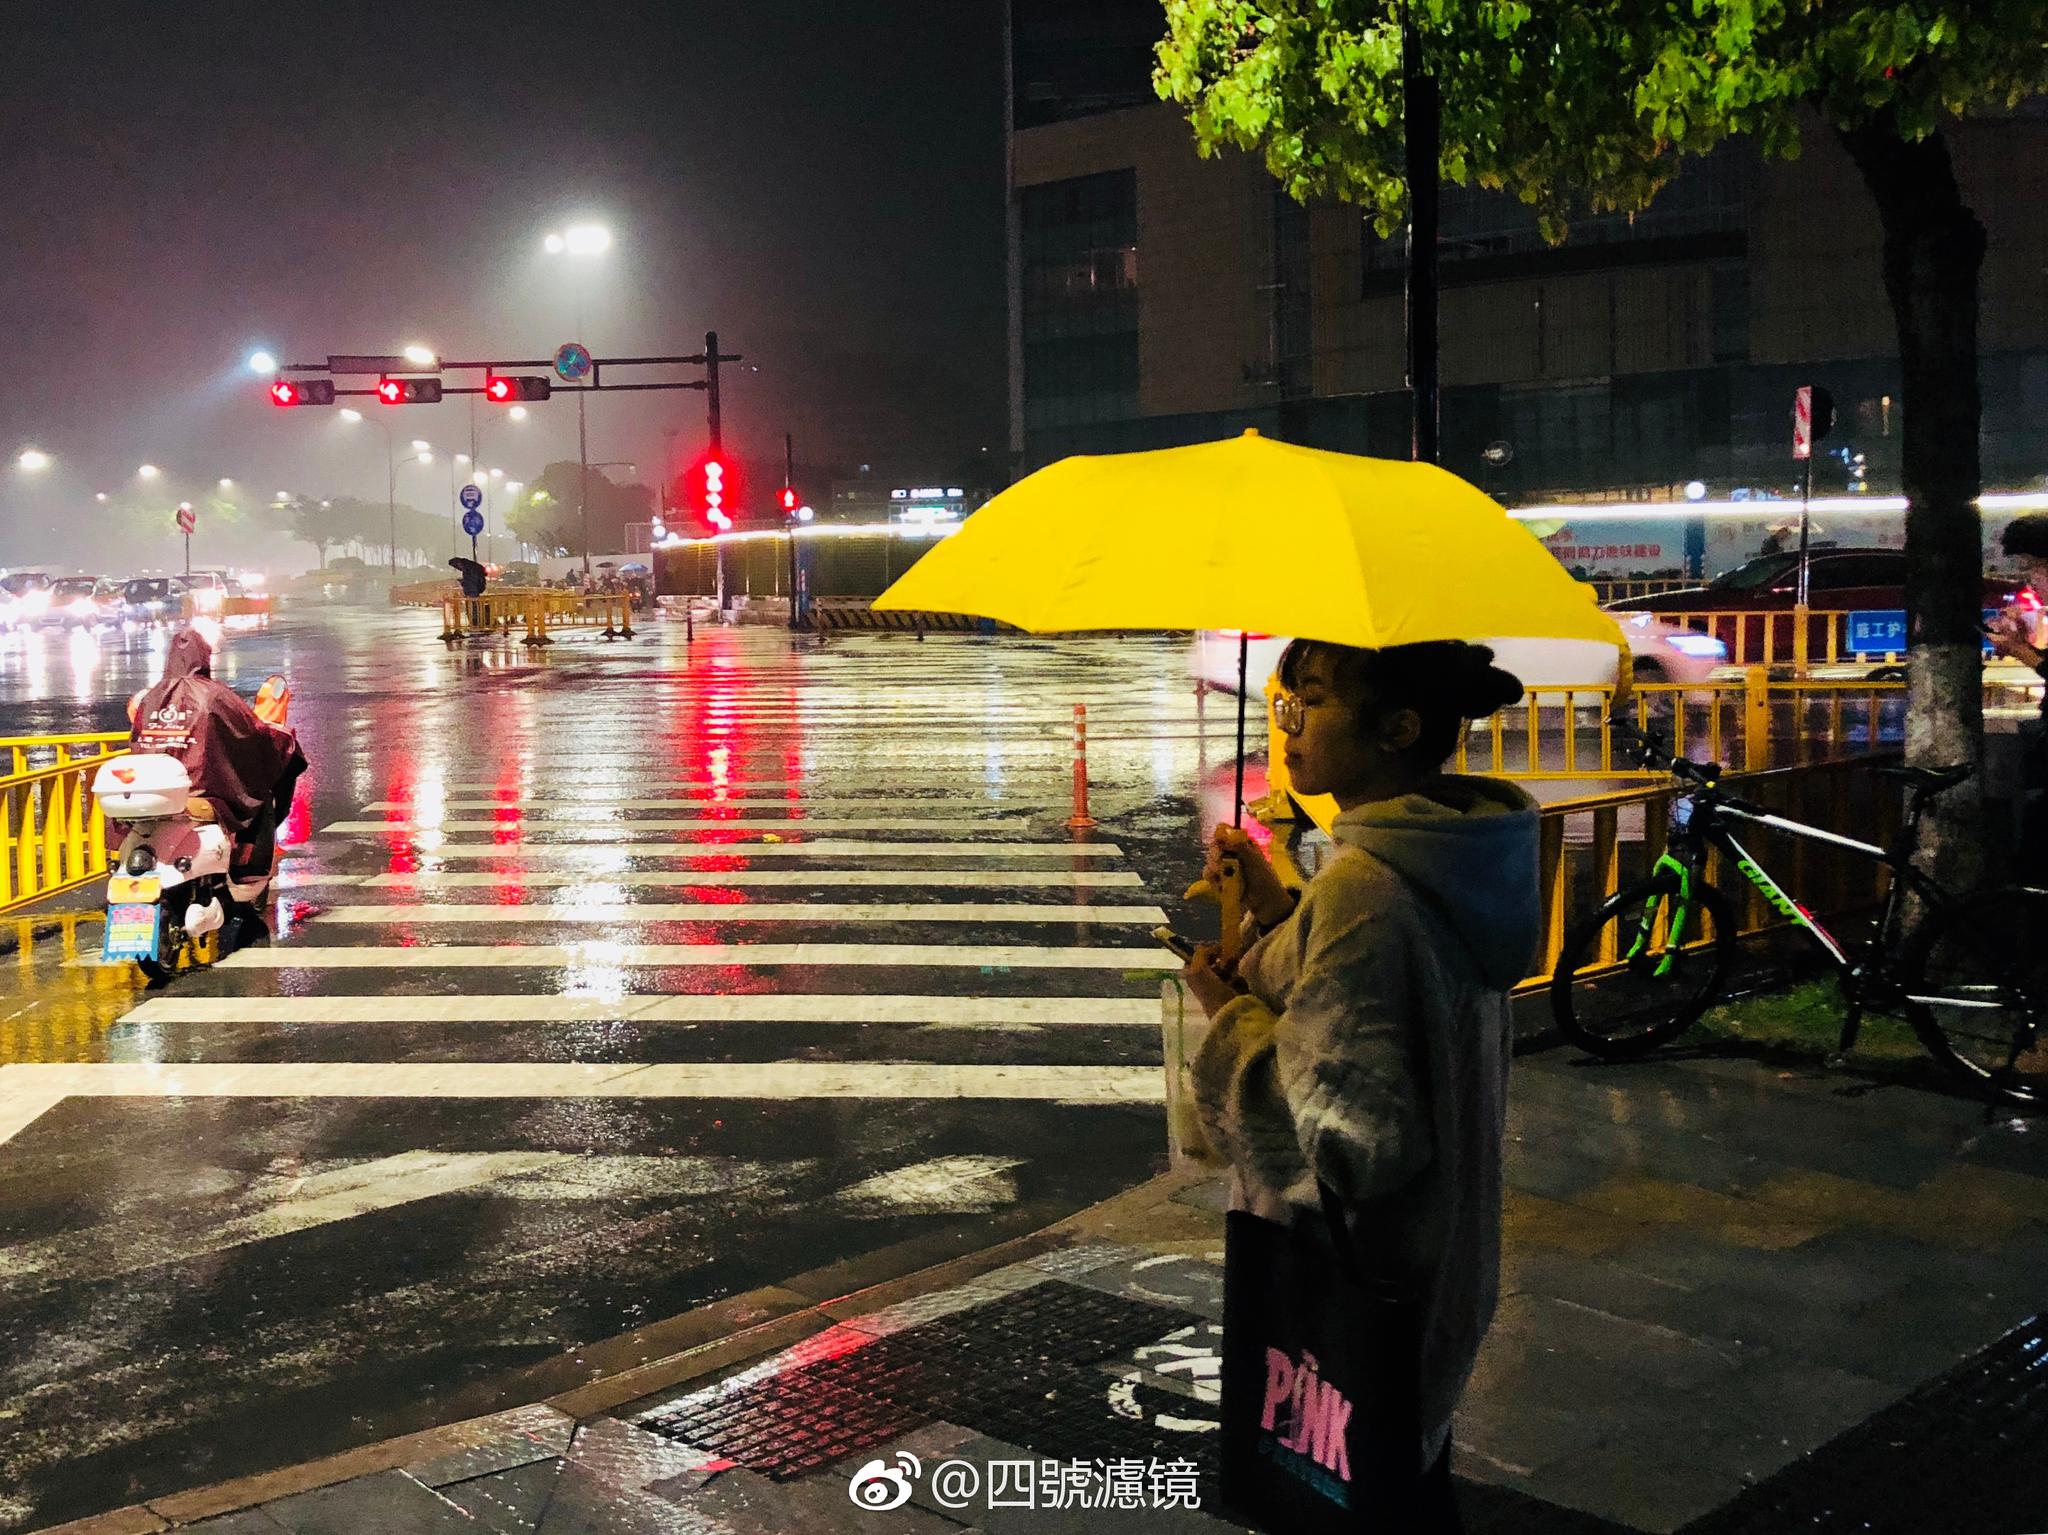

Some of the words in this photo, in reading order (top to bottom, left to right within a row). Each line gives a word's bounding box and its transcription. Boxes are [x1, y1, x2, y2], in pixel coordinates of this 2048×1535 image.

[1856, 622, 1906, 638] 施工护
[1737, 859, 1808, 927] GIANT
